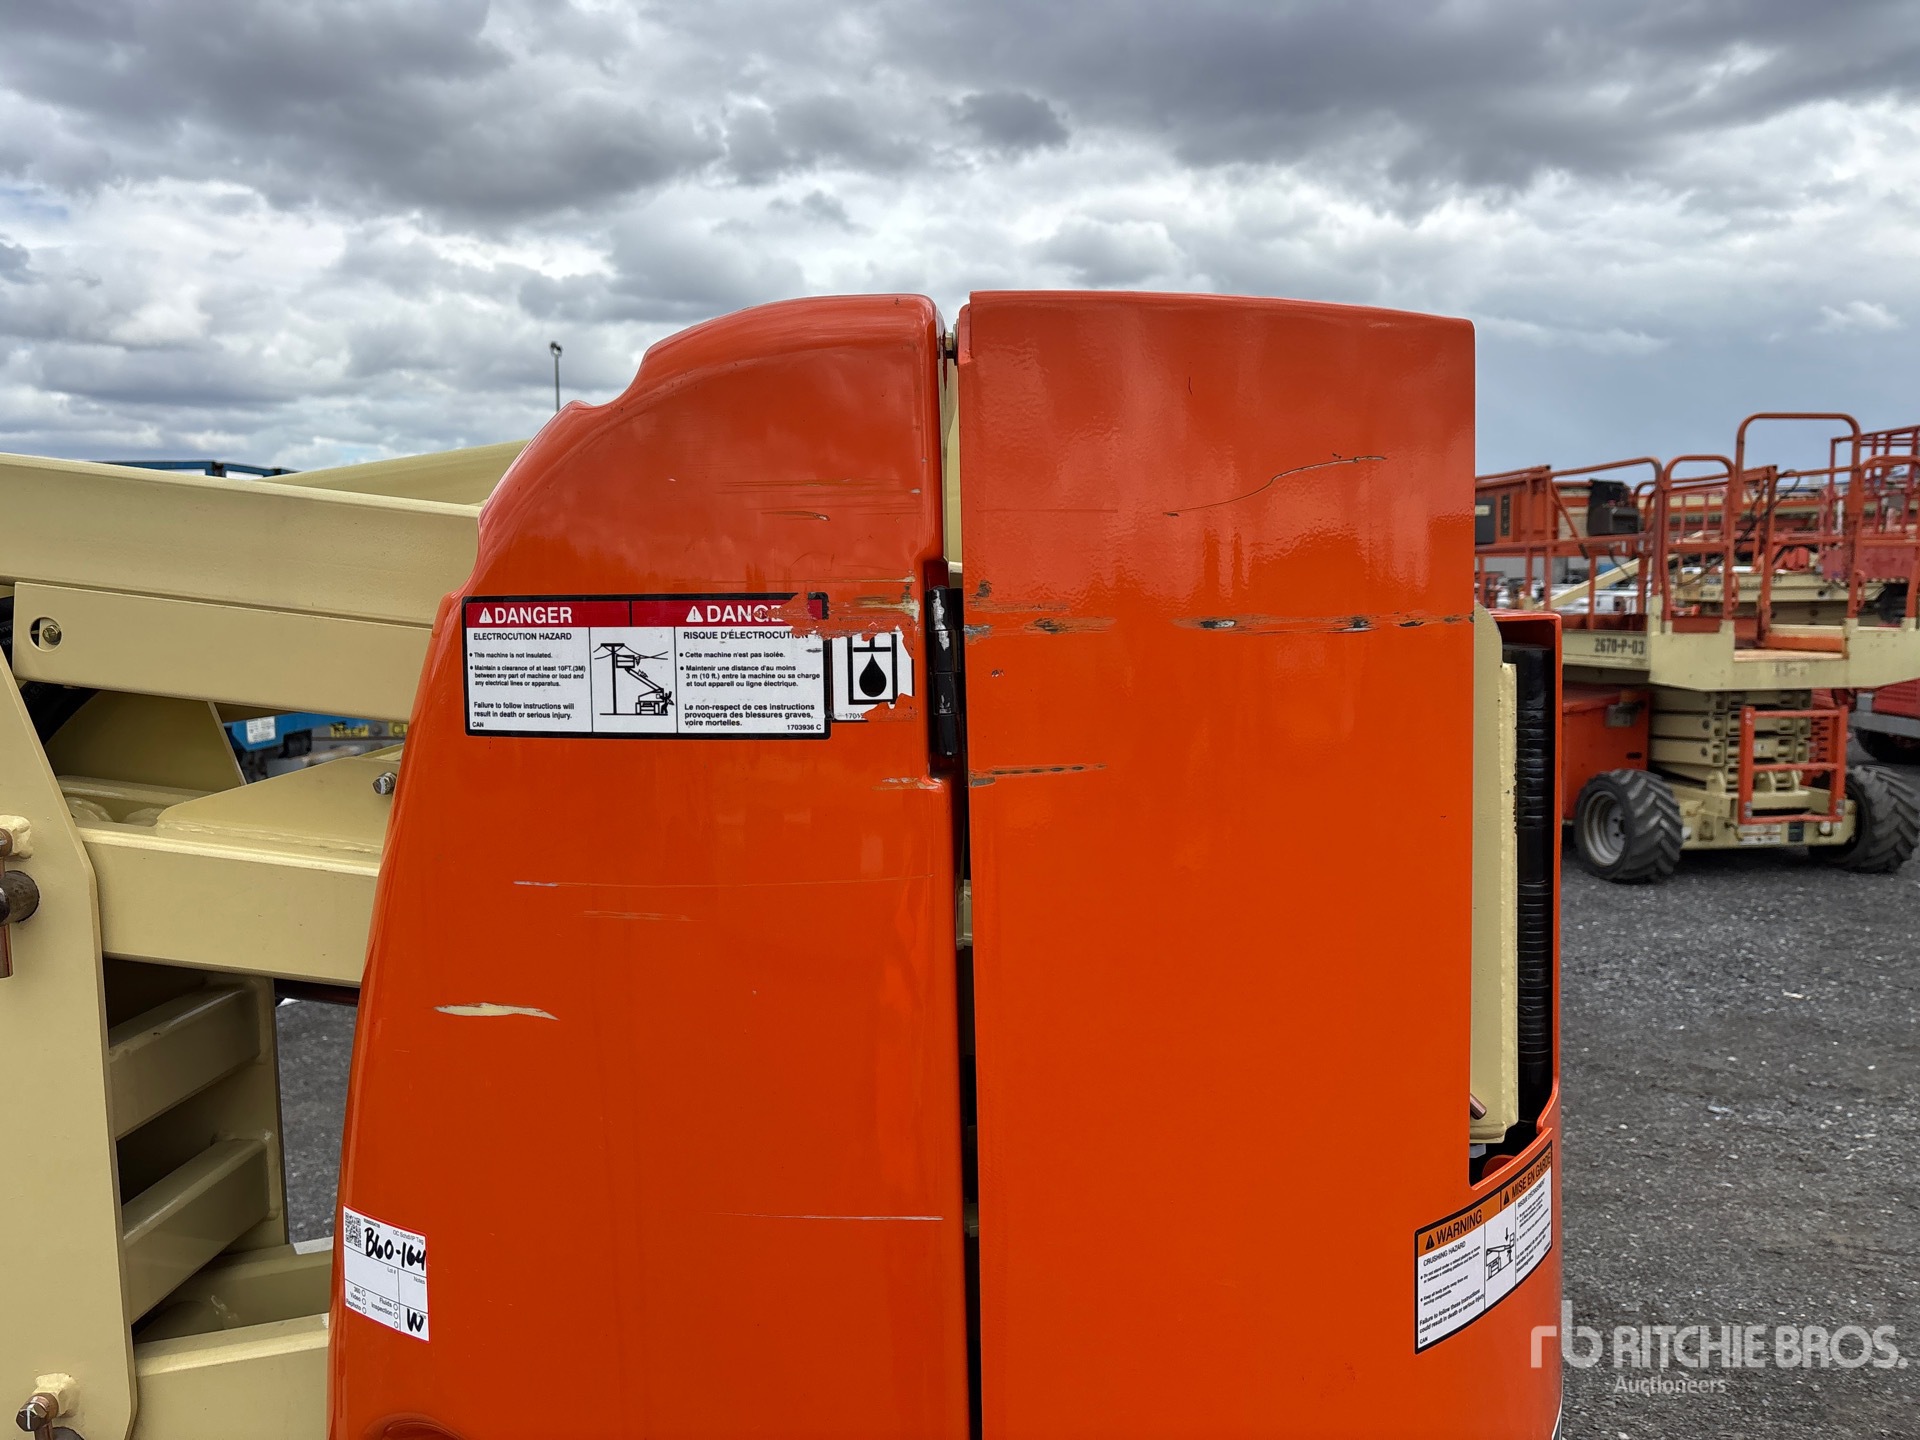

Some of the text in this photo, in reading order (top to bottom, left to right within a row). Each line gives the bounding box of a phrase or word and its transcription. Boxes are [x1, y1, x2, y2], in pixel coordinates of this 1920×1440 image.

[494, 606, 573, 624] DANGER
[706, 605, 785, 622] DANGE
[473, 632, 572, 641] ELECTROCUTION HAZARD
[683, 631, 718, 640] RISQUE
[764, 680, 798, 688] électrique.
[552, 712, 572, 720] injury.
[1436, 1209, 1482, 1245] WARNING
[379, 1297, 392, 1308] Fluids
[371, 1302, 392, 1316] Inspection
